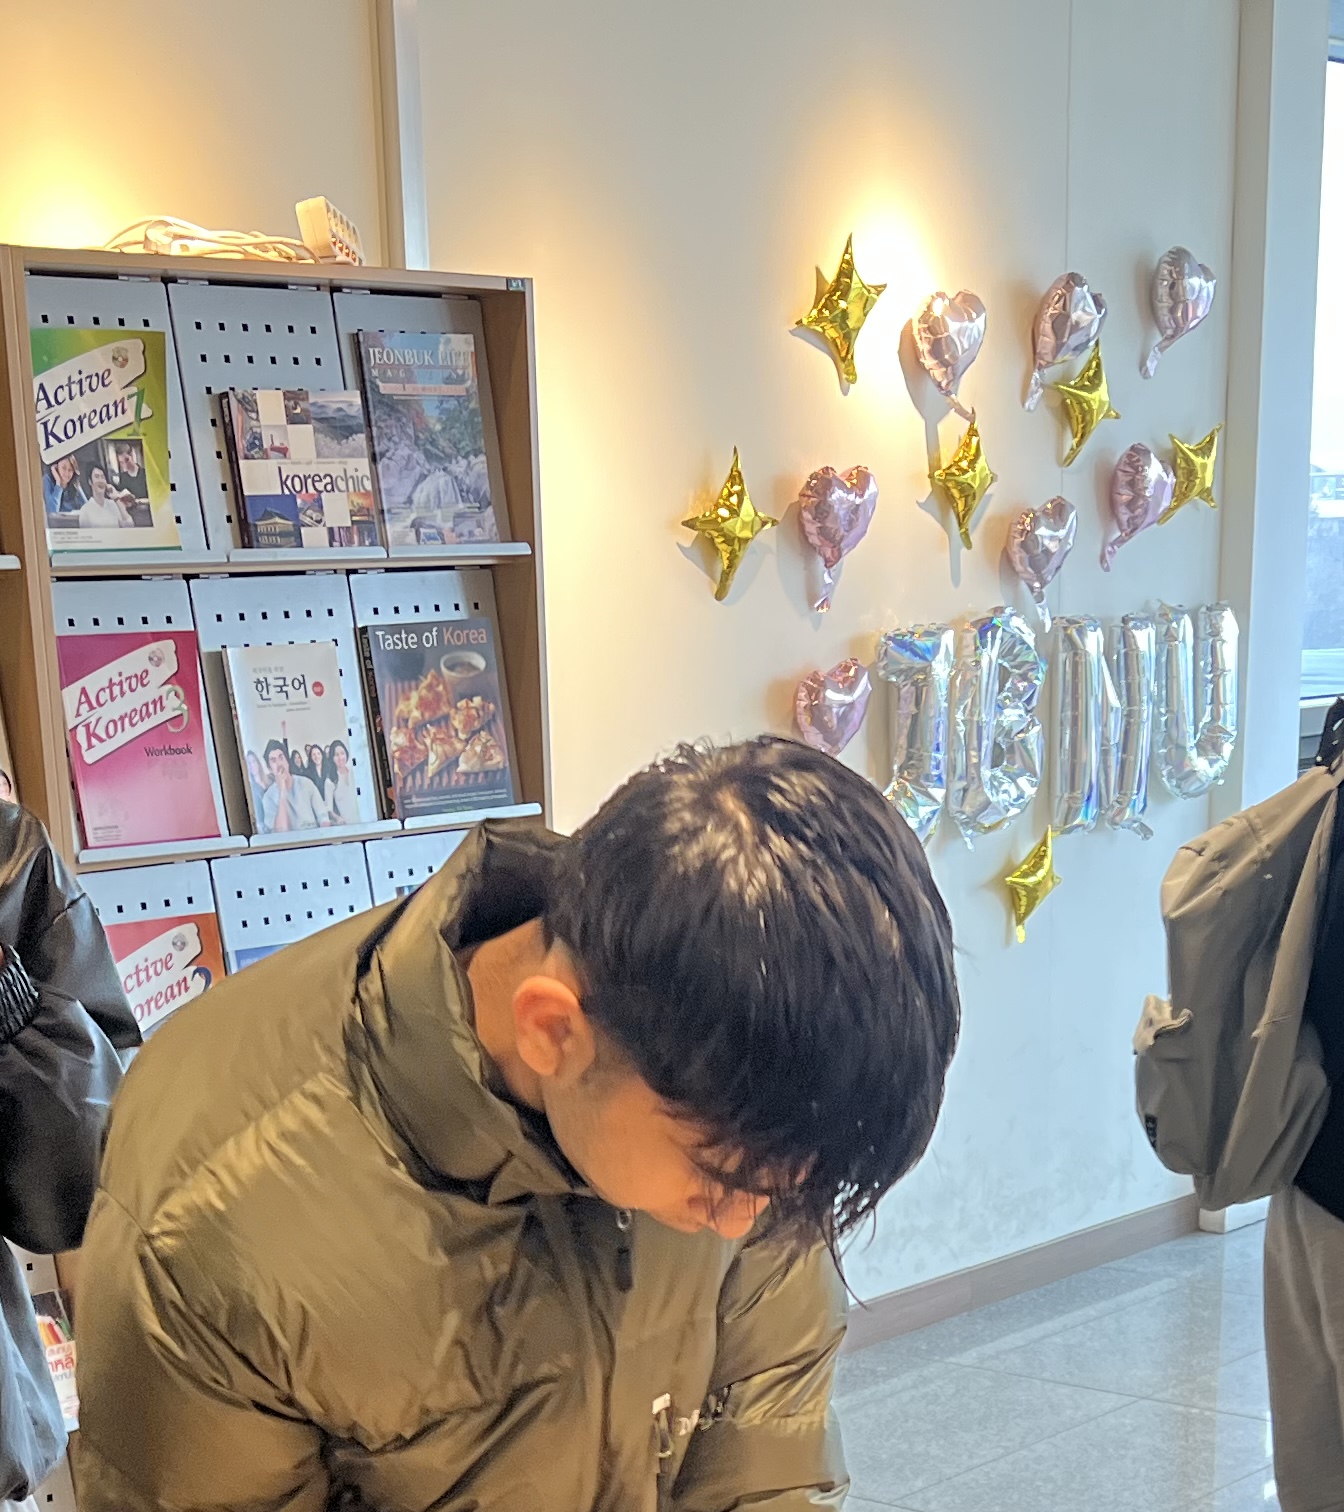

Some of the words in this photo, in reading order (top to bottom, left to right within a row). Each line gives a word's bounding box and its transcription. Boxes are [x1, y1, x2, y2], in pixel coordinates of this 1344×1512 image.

[368, 347, 434, 367] JEONBUK
[35, 368, 113, 414] Active
[40, 396, 128, 452] Korean
[375, 631, 418, 650] Taste
[422, 627, 438, 647] of
[442, 627, 487, 645] Korea
[75, 669, 150, 719] Active
[253, 674, 309, 701] 한국어
[83, 694, 166, 752] Korean
[144, 745, 193, 757] Workbook
[123, 952, 174, 994] ctive
[133, 975, 190, 1023] orean
